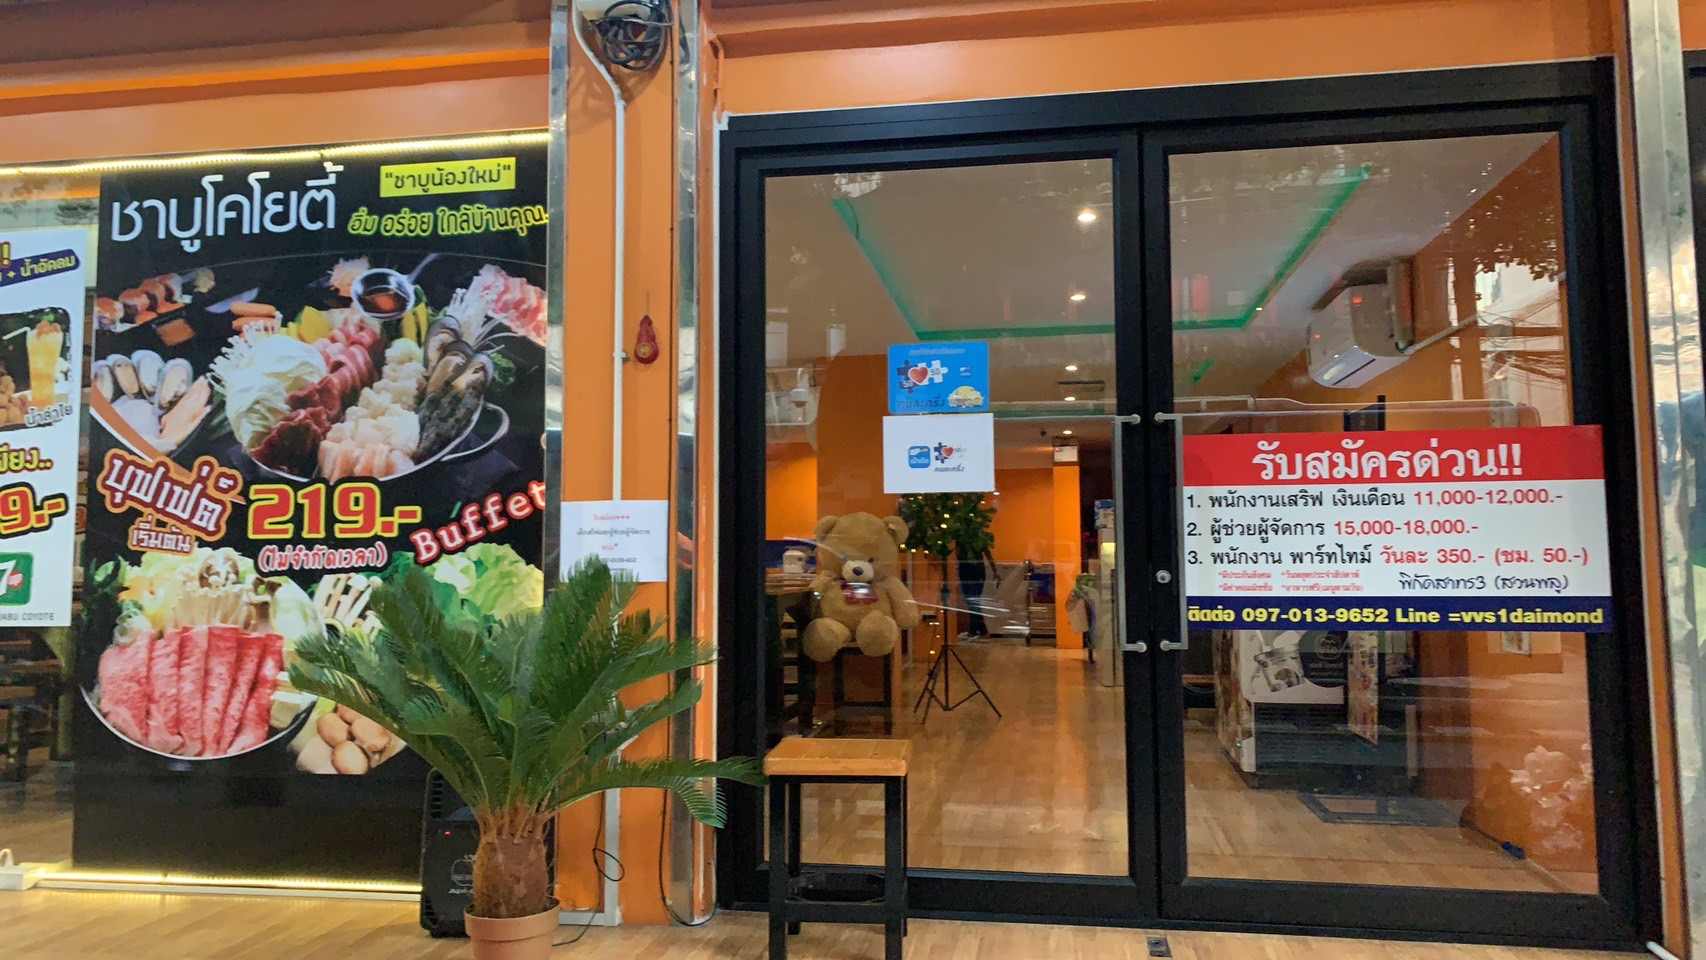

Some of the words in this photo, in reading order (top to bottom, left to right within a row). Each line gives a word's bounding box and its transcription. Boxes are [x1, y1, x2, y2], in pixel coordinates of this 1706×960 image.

[384, 163, 511, 193] "ชาบูน้องใหม่"
[111, 161, 344, 253] ชาบูโคโยตี้
[348, 207, 378, 234] อิ่ม
[381, 208, 433, 236] อร่อย
[1252, 437, 1523, 481] รับสมัครด่วน!!
[247, 482, 422, 539] 219.-
[1187, 494, 1202, 508] 1.
[1209, 490, 1323, 509] พนักงานเสริฟ
[1332, 486, 1405, 508] เงินเดือน
[1414, 488, 1564, 506] 11,000-12,000.-
[410, 480, 546, 564] Buffet
[1187, 521, 1202, 536] 2.
[1210, 517, 1325, 544] ผู้ช่วยผู้จัดการ
[257, 540, 388, 573] (ไม่จำกัดเวลา)
[1187, 550, 1202, 564] 3.
[1210, 546, 1282, 565] พนักงาน
[1290, 543, 1372, 565] พาร์ทไทม์
[1380, 544, 1429, 564] วันละ
[1436, 549, 1485, 564] 350.-
[1494, 547, 1534, 565] (ชม.
[1543, 546, 1589, 565] 50.-)
[1398, 571, 1486, 590] พิกัดสาทร3
[1494, 575, 1569, 594] (สวนพลู)
[1187, 605, 1236, 622] ติดต่อ
[1241, 607, 1389, 622] 097-013-9652
[1396, 608, 1440, 623] Line
[1448, 608, 1604, 624] =vvs1daimond
